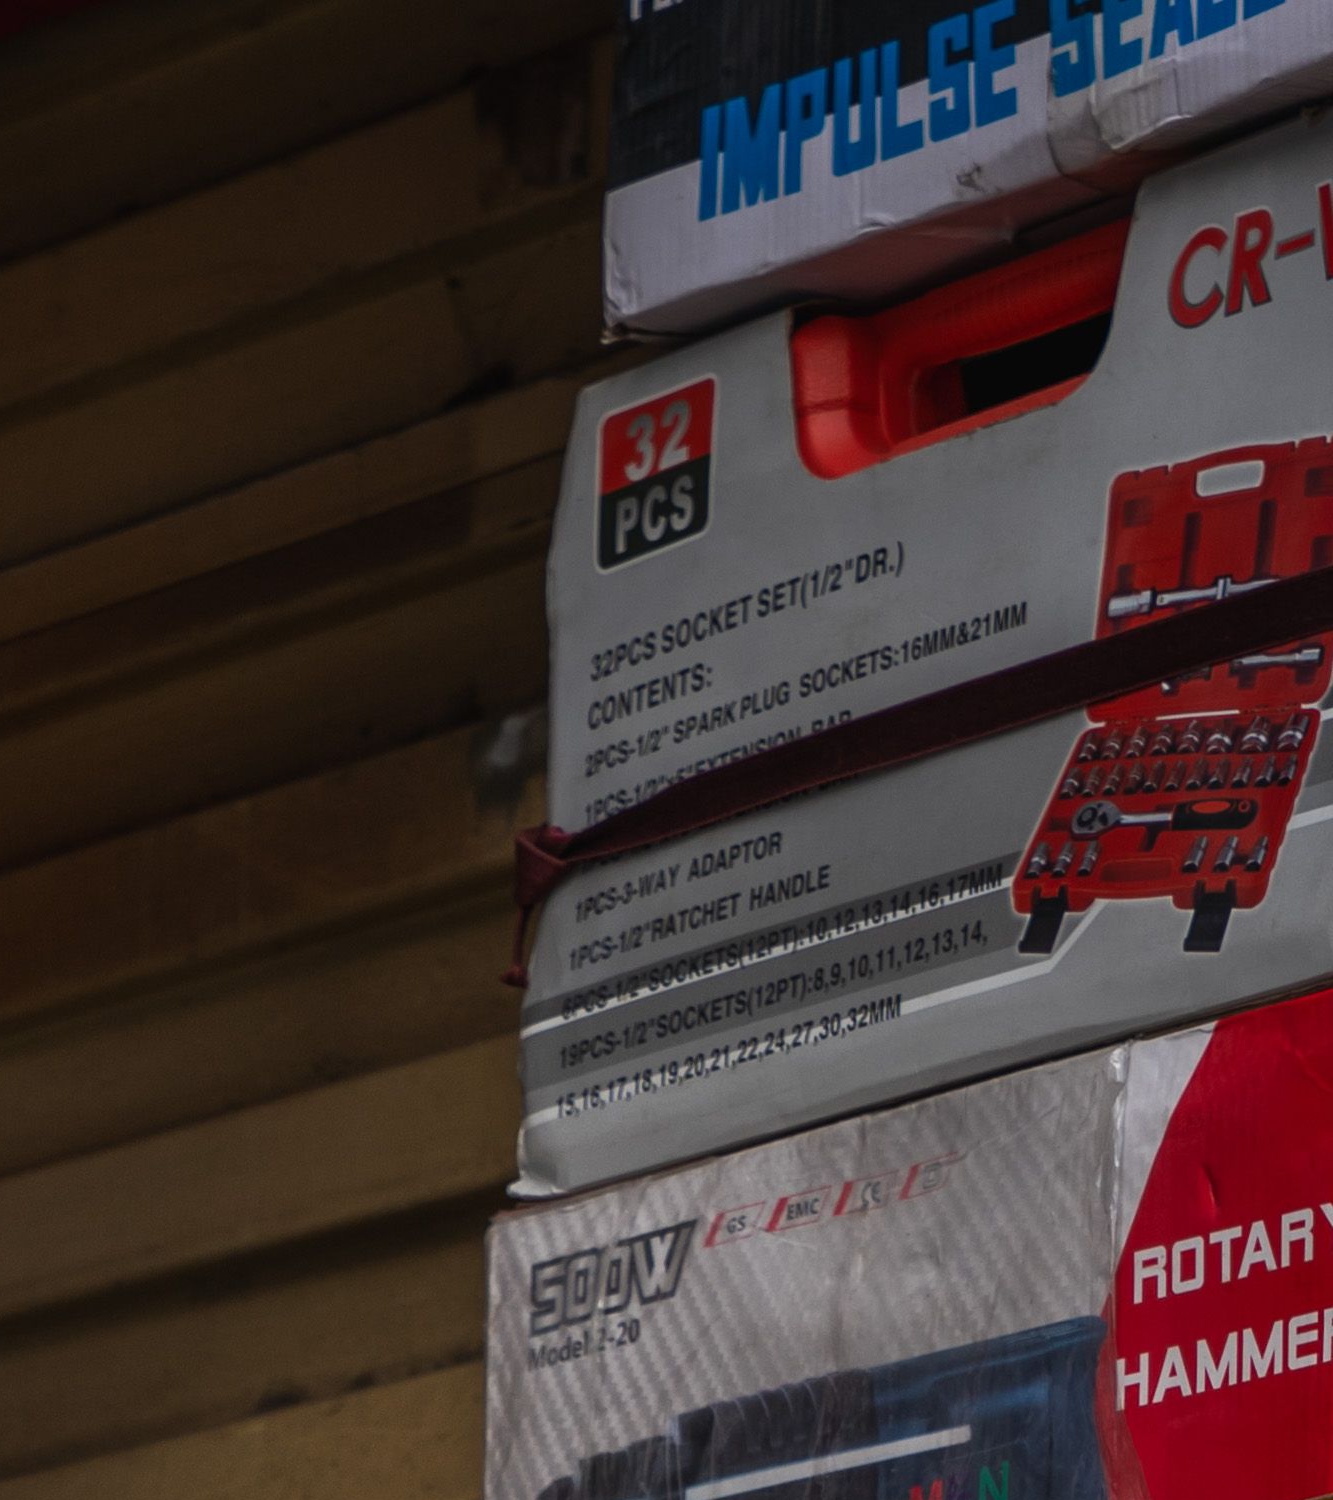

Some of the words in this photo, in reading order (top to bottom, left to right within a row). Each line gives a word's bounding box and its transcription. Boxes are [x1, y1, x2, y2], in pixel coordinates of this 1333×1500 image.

[698, 0, 1018, 222] IMPULSE
[1051, 0, 1285, 97] SEA
[1168, 180, 1333, 329] CR-
[623, 401, 691, 481] 32
[615, 473, 694, 555] PCS
[590, 627, 656, 682] 32PCS
[661, 595, 753, 655] SOCKET
[587, 664, 713, 730] CONTENTS:
[672, 699, 737, 744] SPARK
[739, 682, 792, 720] PLUG
[574, 863, 678, 924] 1PCS-3-WAY
[687, 832, 783, 883] ADAPTOR
[749, 865, 831, 912] HANDLE
[786, 1197, 820, 1221] EMC
